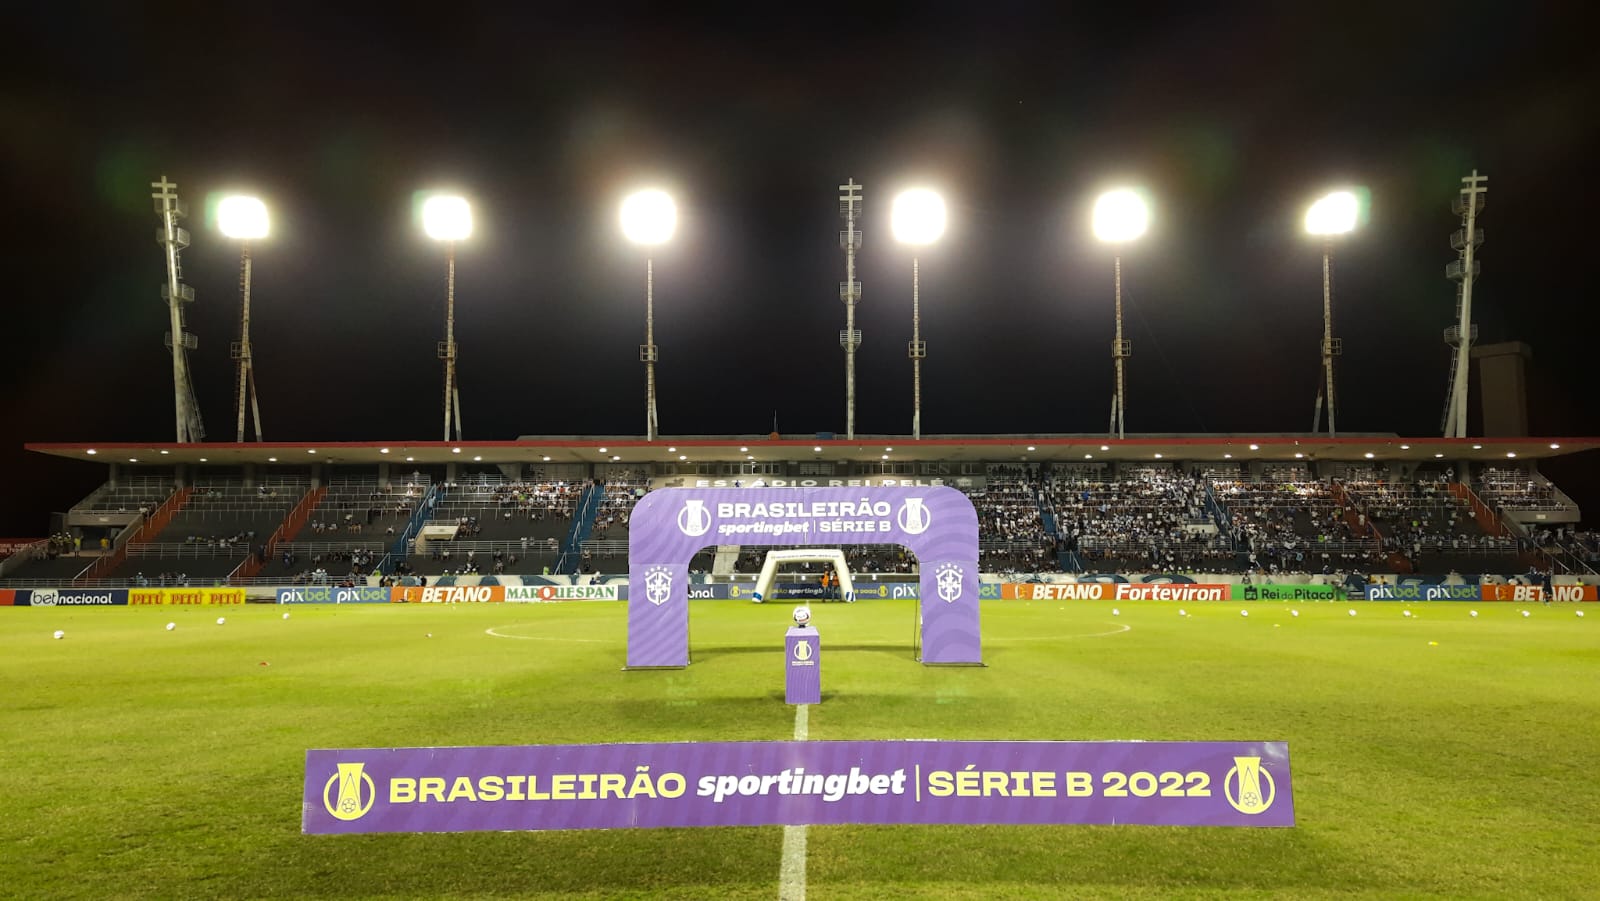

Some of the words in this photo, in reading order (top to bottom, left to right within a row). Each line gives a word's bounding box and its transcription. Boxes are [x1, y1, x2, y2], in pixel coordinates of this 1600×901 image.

[696, 478, 818, 487] ESTÁDIO
[828, 479, 870, 487] REI
[882, 478, 944, 487] PELÉ
[717, 498, 891, 518] BRASILEIRÃO
[718, 521, 809, 536] sportingbet
[819, 519, 875, 532] SÉRIE
[879, 521, 891, 532] B
[281, 587, 331, 604] pixbet
[337, 587, 387, 604] pixbet
[421, 587, 492, 602] BETANO
[507, 586, 615, 601] MARQUESPAN
[1032, 584, 1103, 600] BETANO
[1116, 584, 1221, 601] Forteviron
[1262, 588, 1280, 600] Rei
[1281, 592, 1293, 600] do
[1294, 588, 1334, 600] Pitaco
[1370, 585, 1420, 601] pixbet
[1427, 585, 1478, 601] pixbet
[390, 766, 687, 803] BRASILEIRÃO
[697, 767, 906, 803] sportingbet
[928, 764, 1056, 797] SÉRIE
[1066, 772, 1094, 797] B
[1102, 771, 1211, 797] 2022
